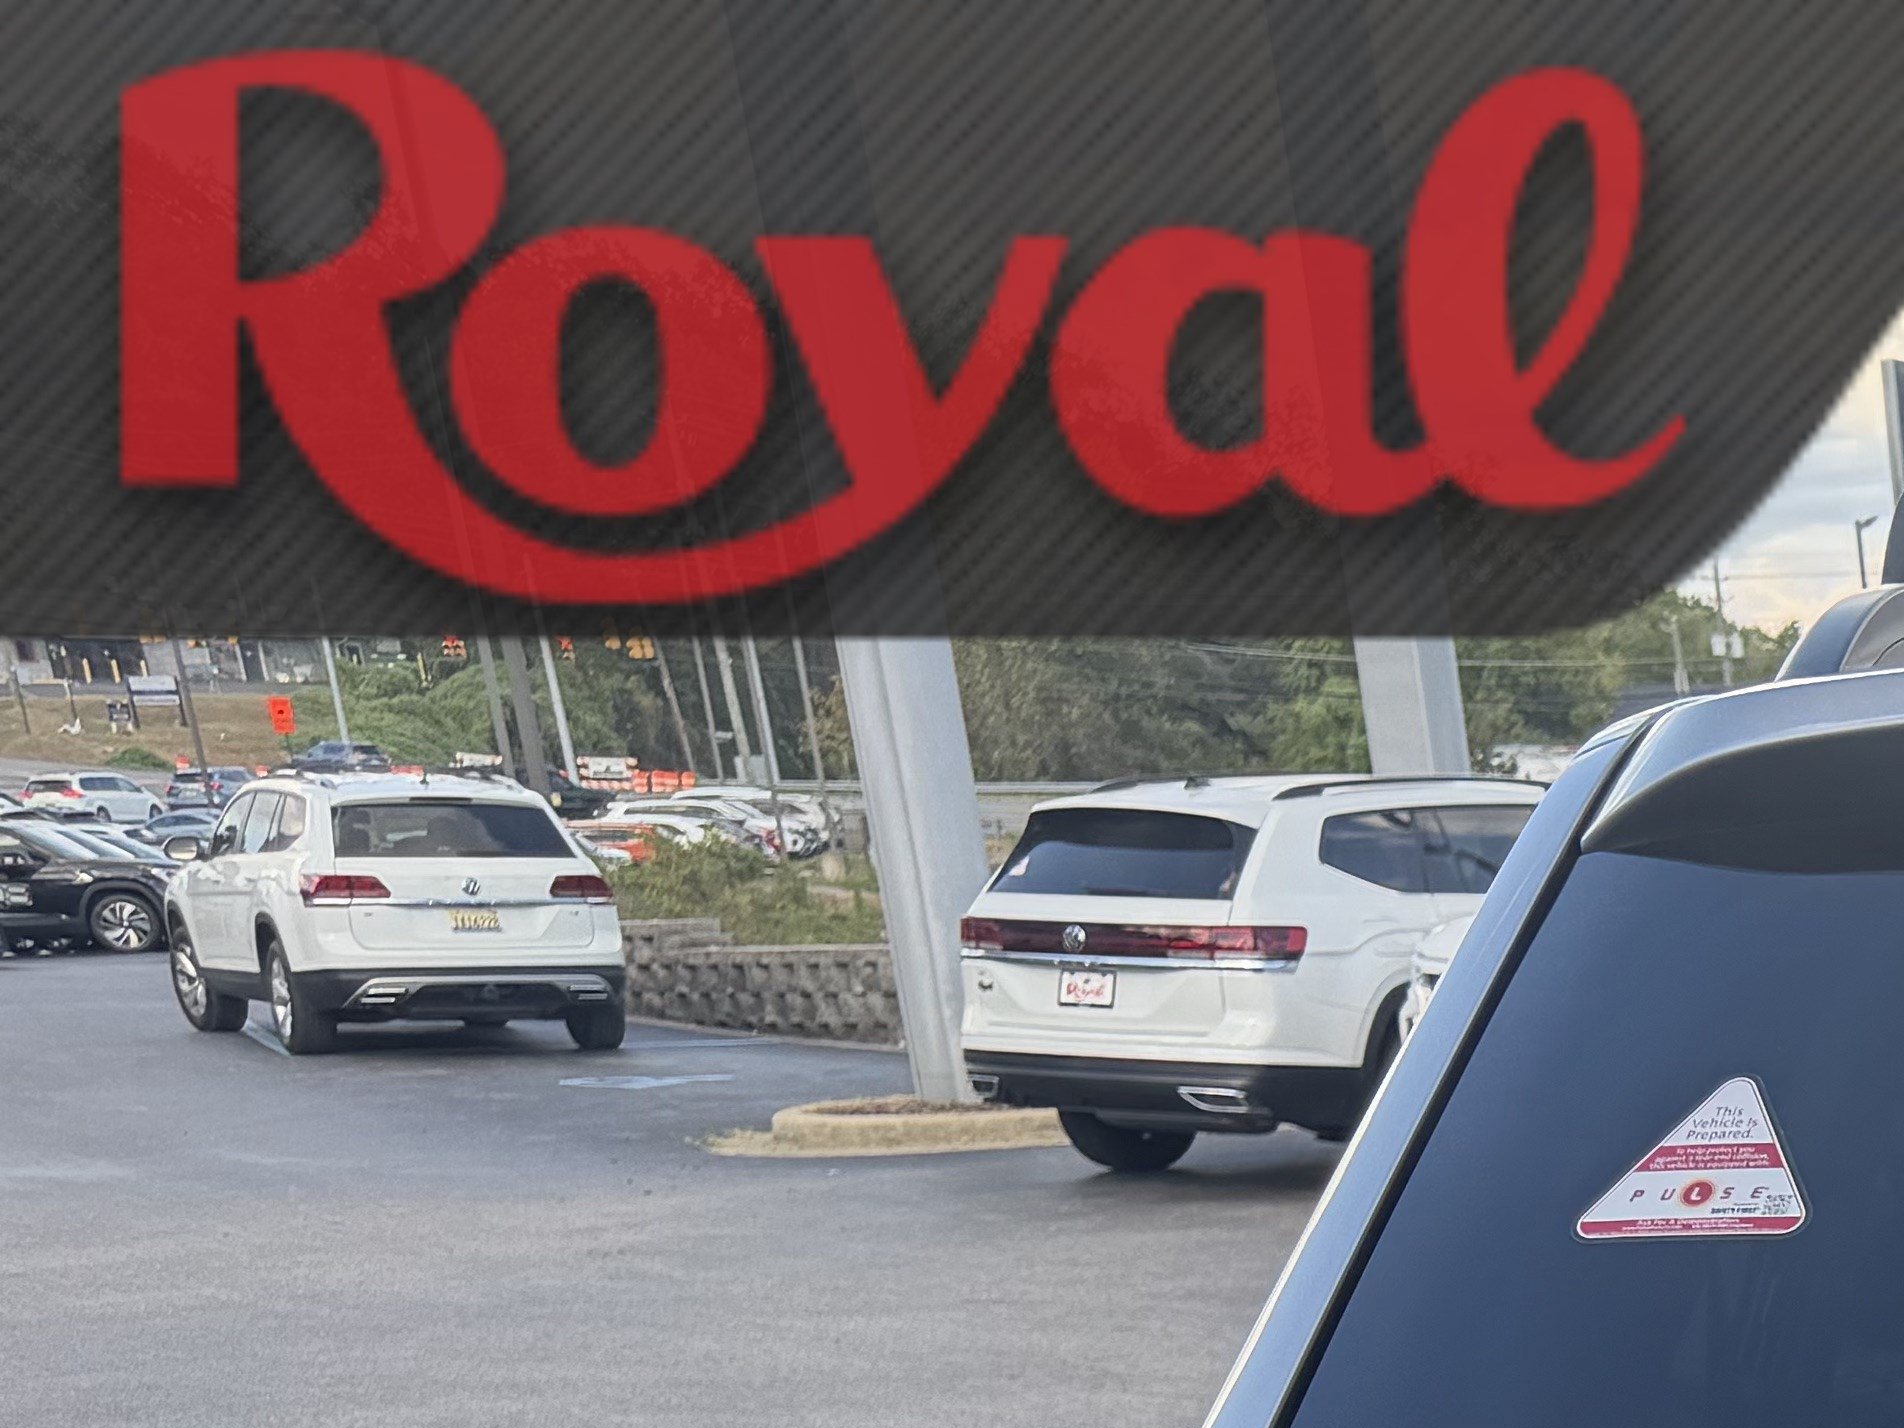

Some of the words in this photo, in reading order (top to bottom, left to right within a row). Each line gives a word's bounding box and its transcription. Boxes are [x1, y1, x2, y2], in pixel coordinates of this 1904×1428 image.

[1716, 1106, 1745, 1117] This
[1692, 1117, 1744, 1129] Vehicle
[1686, 1129, 1754, 1142] Prepared.
